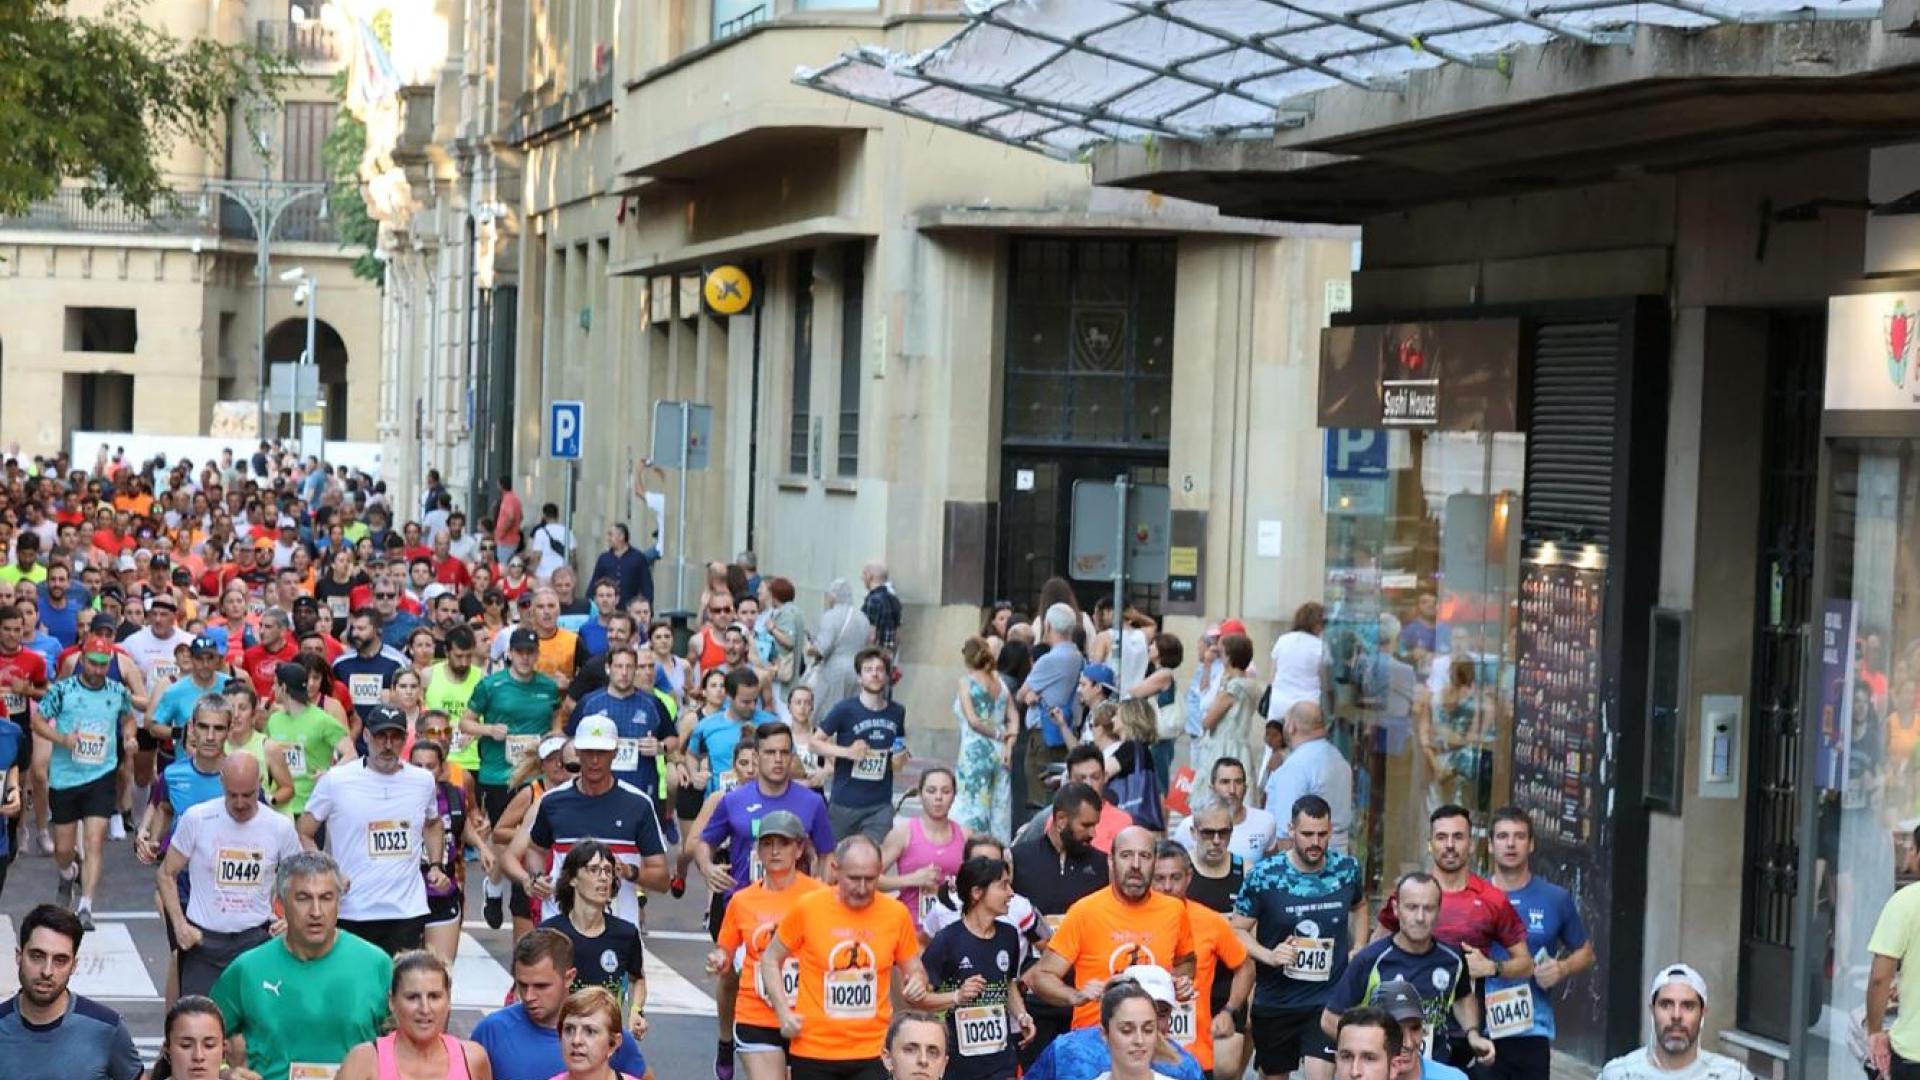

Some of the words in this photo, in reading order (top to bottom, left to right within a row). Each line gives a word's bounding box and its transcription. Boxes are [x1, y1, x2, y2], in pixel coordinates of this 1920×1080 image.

[1384, 388, 1407, 416] Sushi
[1409, 390, 1436, 416] House
[556, 409, 575, 452] P
[1337, 430, 1375, 471] P
[1184, 476, 1193, 492] 5
[373, 830, 407, 851] 10323
[222, 860, 260, 881] 10449
[832, 984, 871, 1005] 10200
[1491, 1000, 1530, 1026] 10440
[964, 1019, 1003, 1043] 10203
